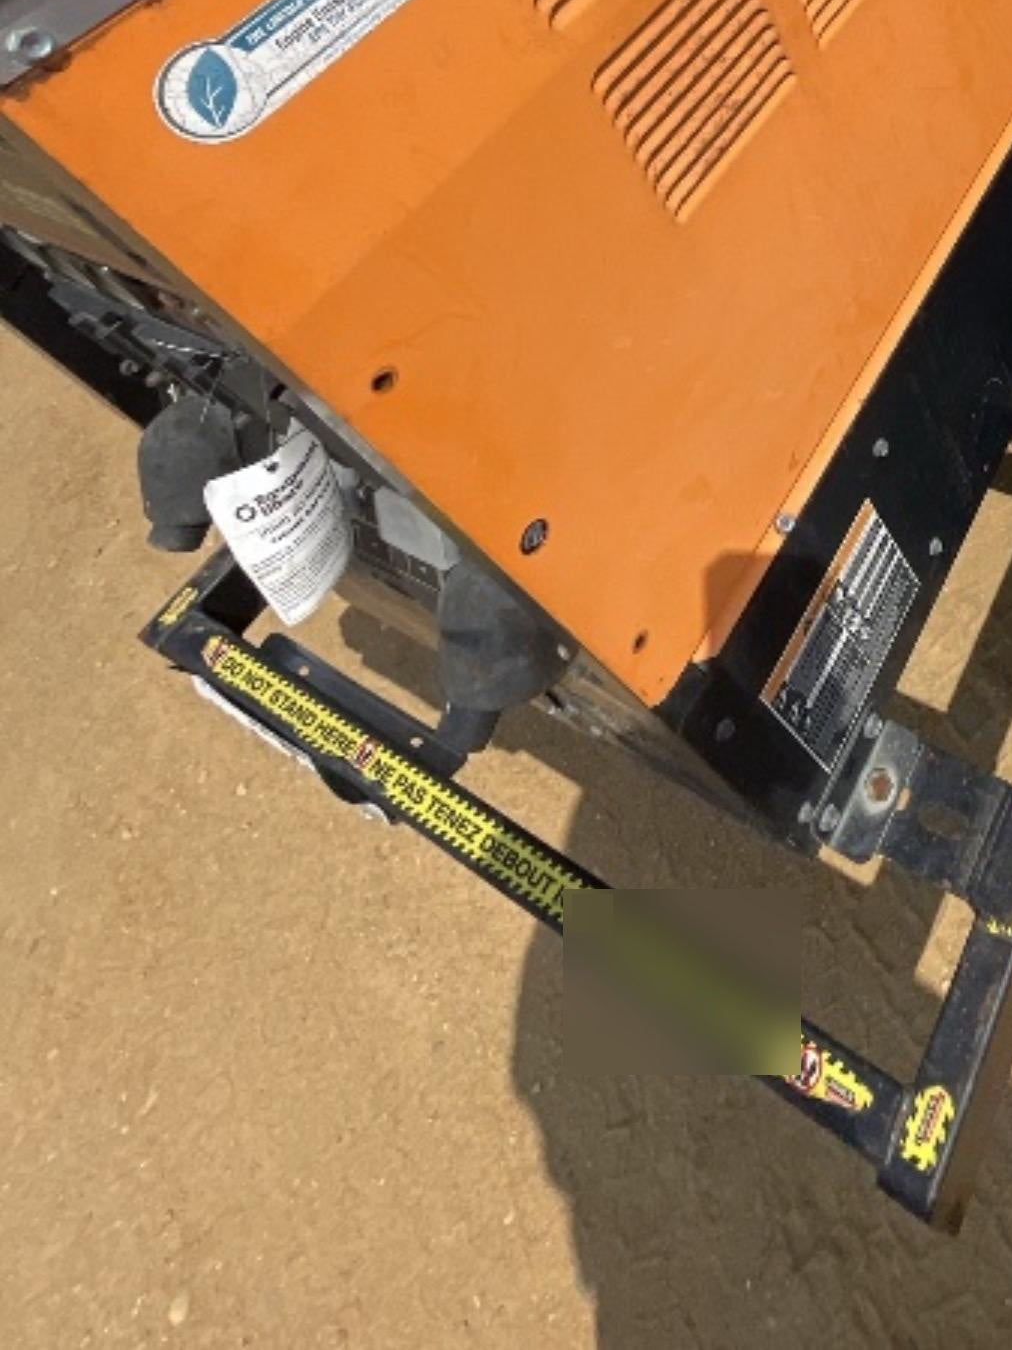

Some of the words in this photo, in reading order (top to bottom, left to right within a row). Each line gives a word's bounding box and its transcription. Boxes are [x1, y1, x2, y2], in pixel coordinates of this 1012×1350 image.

[221, 656, 246, 677] DO
[239, 669, 274, 697] NOT
[269, 690, 318, 727] STAND
[314, 721, 358, 758] HERE
[367, 759, 397, 784] NE
[393, 776, 428, 804] PAS
[426, 795, 484, 843] TENEZ
[479, 833, 557, 894] DEBOUT
